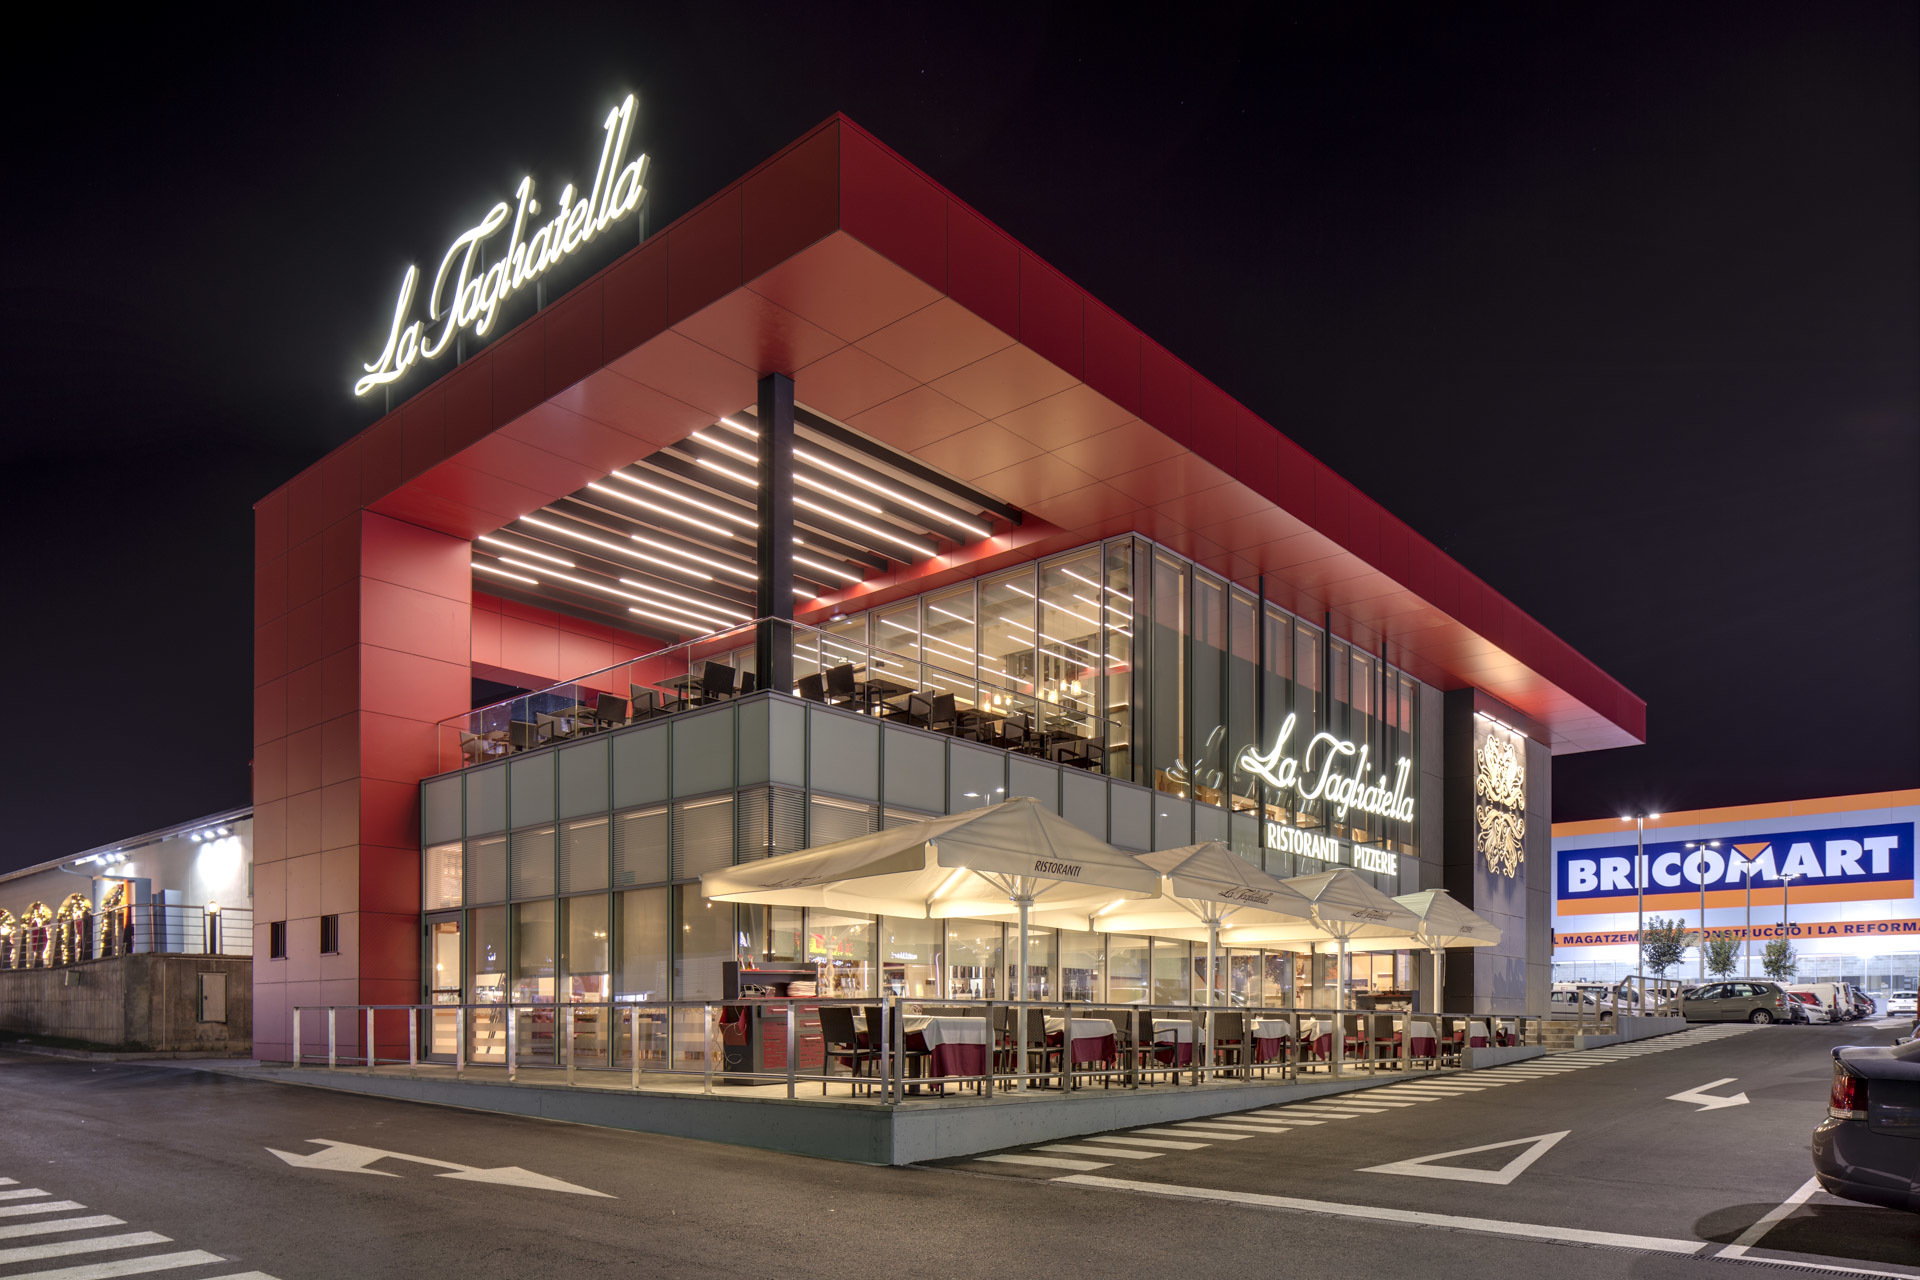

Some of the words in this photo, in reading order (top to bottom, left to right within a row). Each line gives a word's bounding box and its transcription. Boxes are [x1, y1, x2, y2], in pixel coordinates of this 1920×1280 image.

[354, 264, 424, 397] La
[421, 93, 650, 359] Tagliatella
[1241, 712, 1297, 788] La
[1297, 731, 1415, 823] Tagliatella
[1034, 860, 1082, 877] RISTORANTI
[1266, 823, 1339, 864] RISTORANTI
[1353, 844, 1397, 877] PIZZERIE
[1567, 835, 1899, 894] BRICOMART
[1218, 886, 1239, 899] La
[1563, 933, 1639, 945] MAGATZEM
[1808, 926, 1812, 936] I
[1818, 925, 1838, 935] LA
[1844, 921, 1920, 935] REFORM
